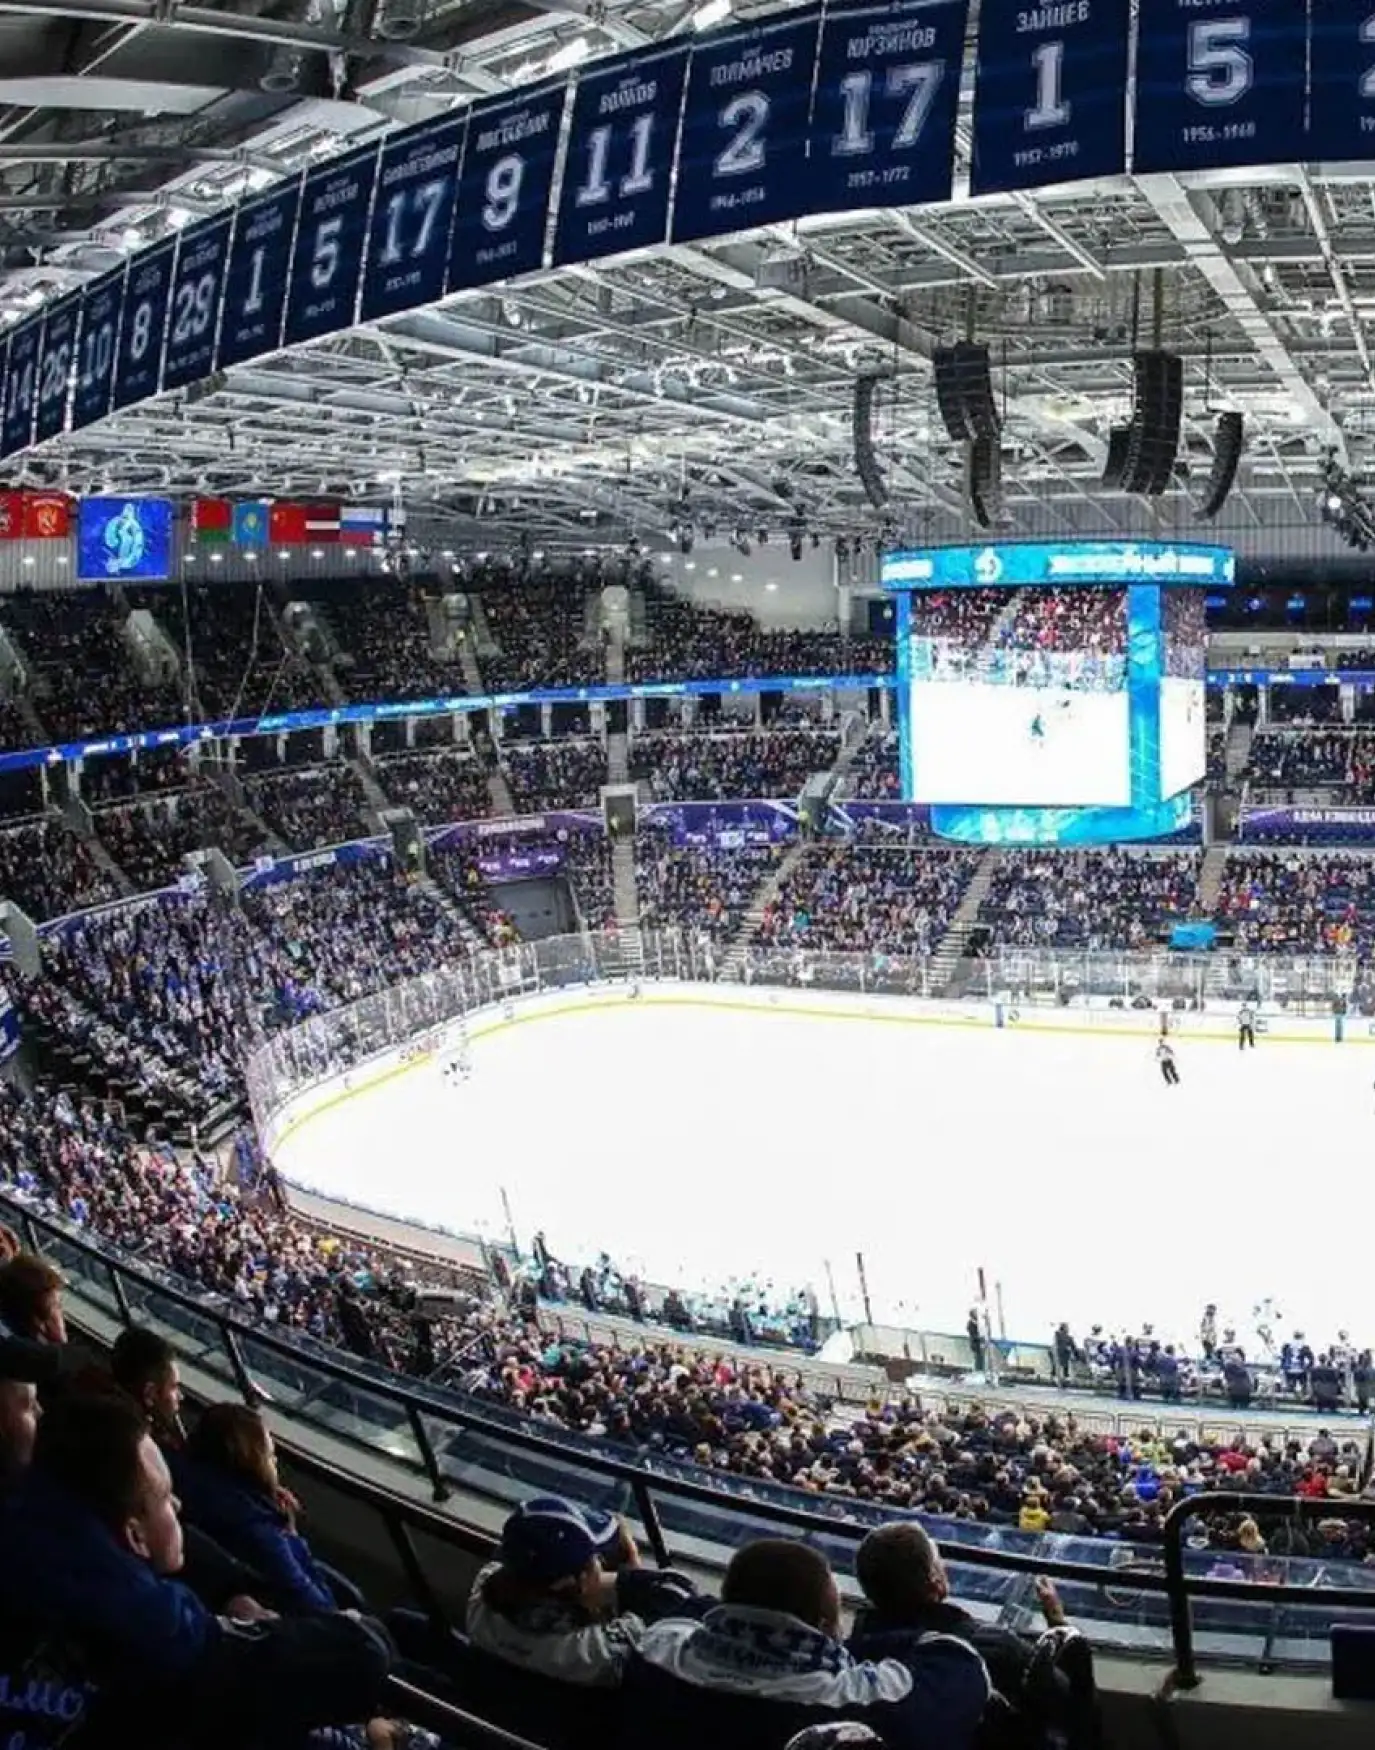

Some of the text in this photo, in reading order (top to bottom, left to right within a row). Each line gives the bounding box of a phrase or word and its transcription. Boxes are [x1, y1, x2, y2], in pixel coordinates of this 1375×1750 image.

[1023, 39, 1072, 132] 1
[1184, 15, 1254, 107] 5
[712, 90, 772, 178] 2
[831, 58, 948, 156] 17
[482, 151, 528, 231] 9
[575, 112, 656, 208] 11
[310, 213, 344, 289] 5
[377, 178, 450, 267] 17
[171, 272, 217, 343] 29
[243, 246, 265, 316] 1
[130, 303, 152, 360] 8
